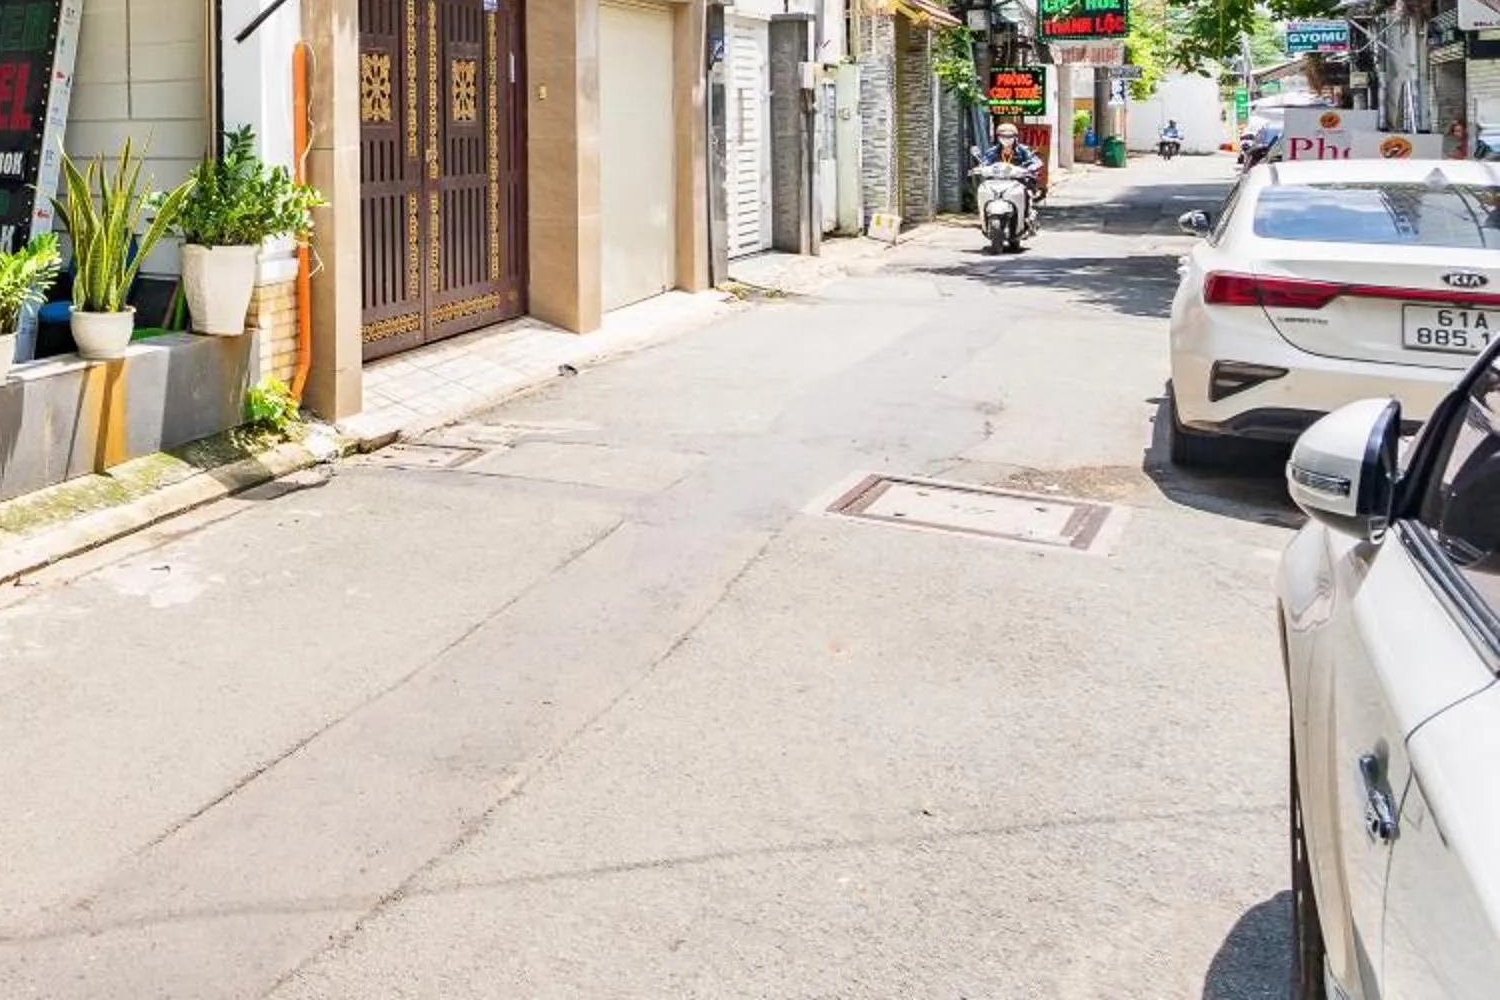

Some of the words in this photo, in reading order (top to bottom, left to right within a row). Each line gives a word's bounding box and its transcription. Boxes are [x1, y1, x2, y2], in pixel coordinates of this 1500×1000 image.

[1289, 31, 1346, 43] GYOMU
[1449, 274, 1481, 287] KIA
[1437, 310, 1489, 330] 61A
[1416, 327, 1491, 348] 885.1
